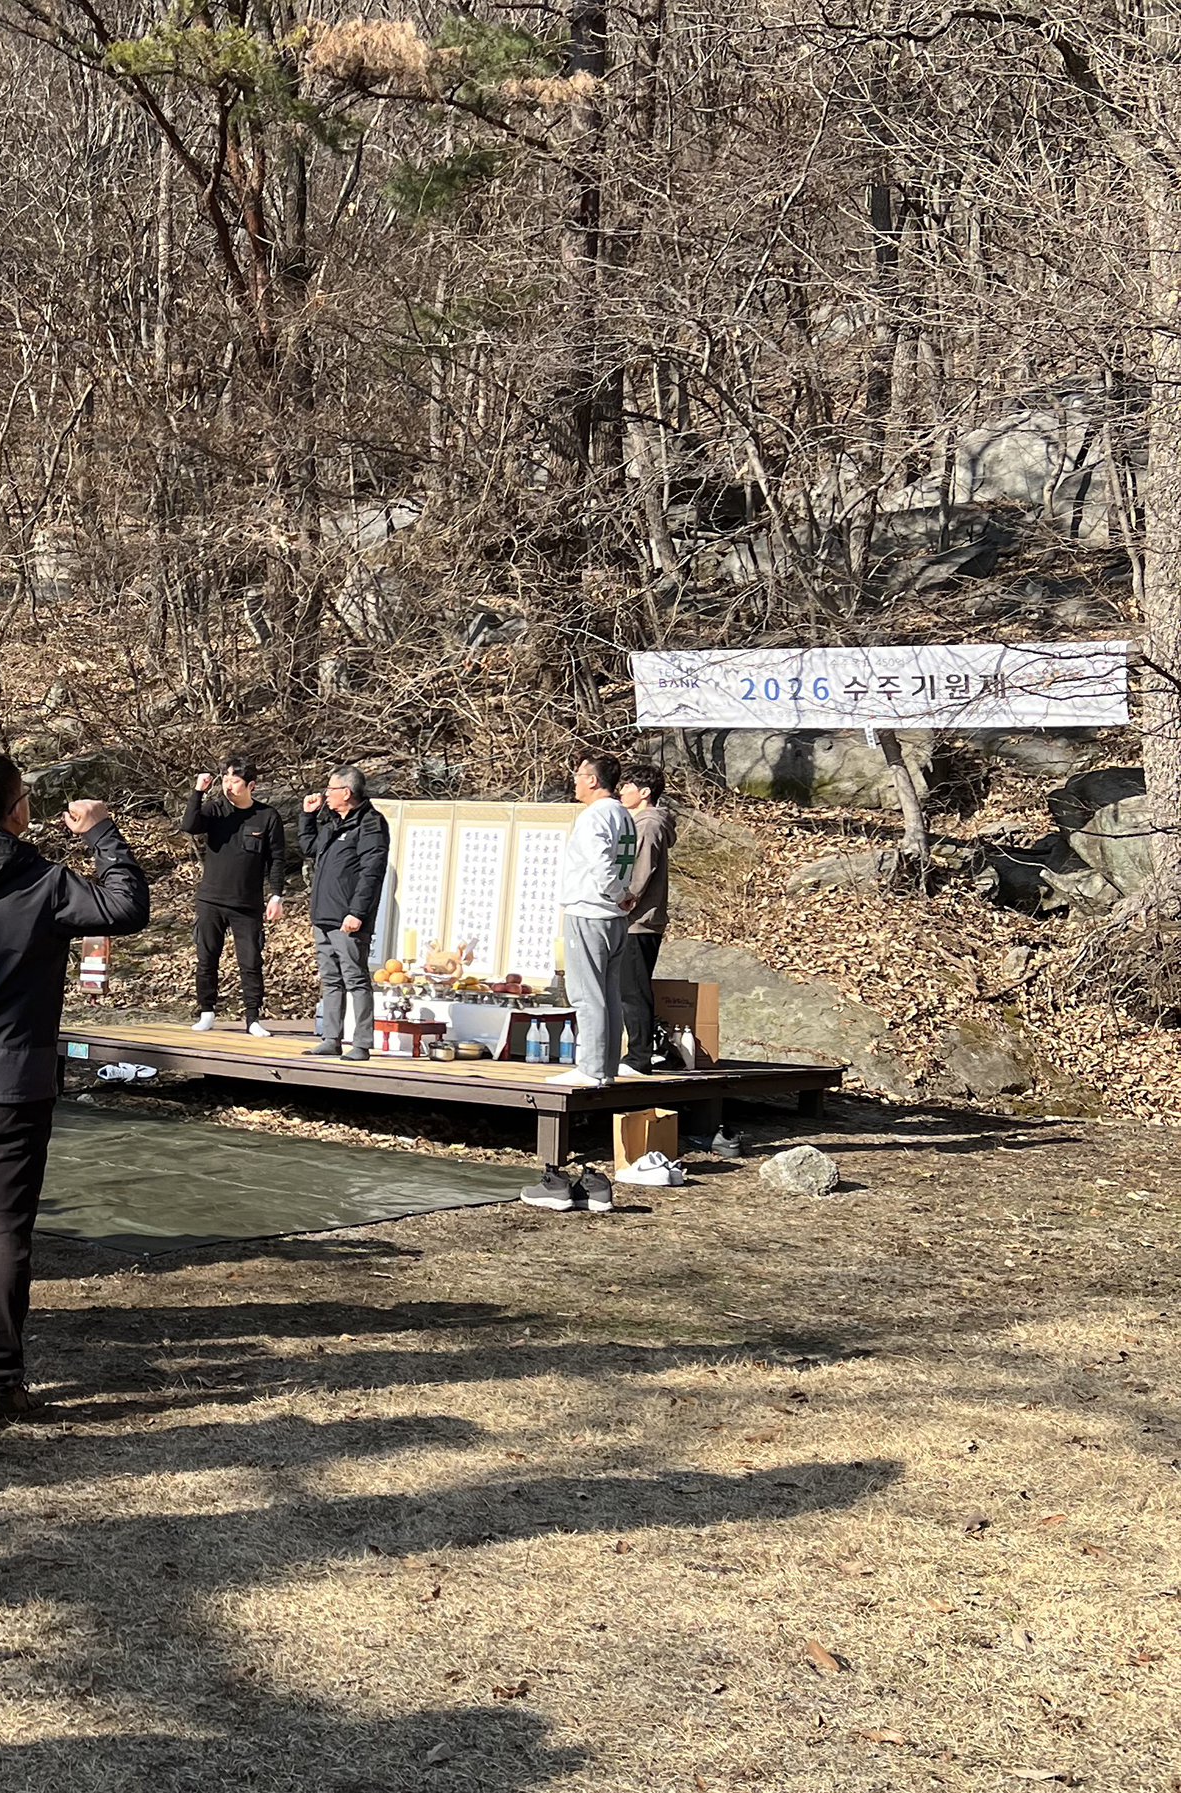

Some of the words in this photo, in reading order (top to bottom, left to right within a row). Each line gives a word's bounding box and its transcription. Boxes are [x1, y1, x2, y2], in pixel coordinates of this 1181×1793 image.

[659, 678, 700, 688] BANK
[740, 677, 830, 701] 2026
[843, 674, 1007, 702] 수주기원제
